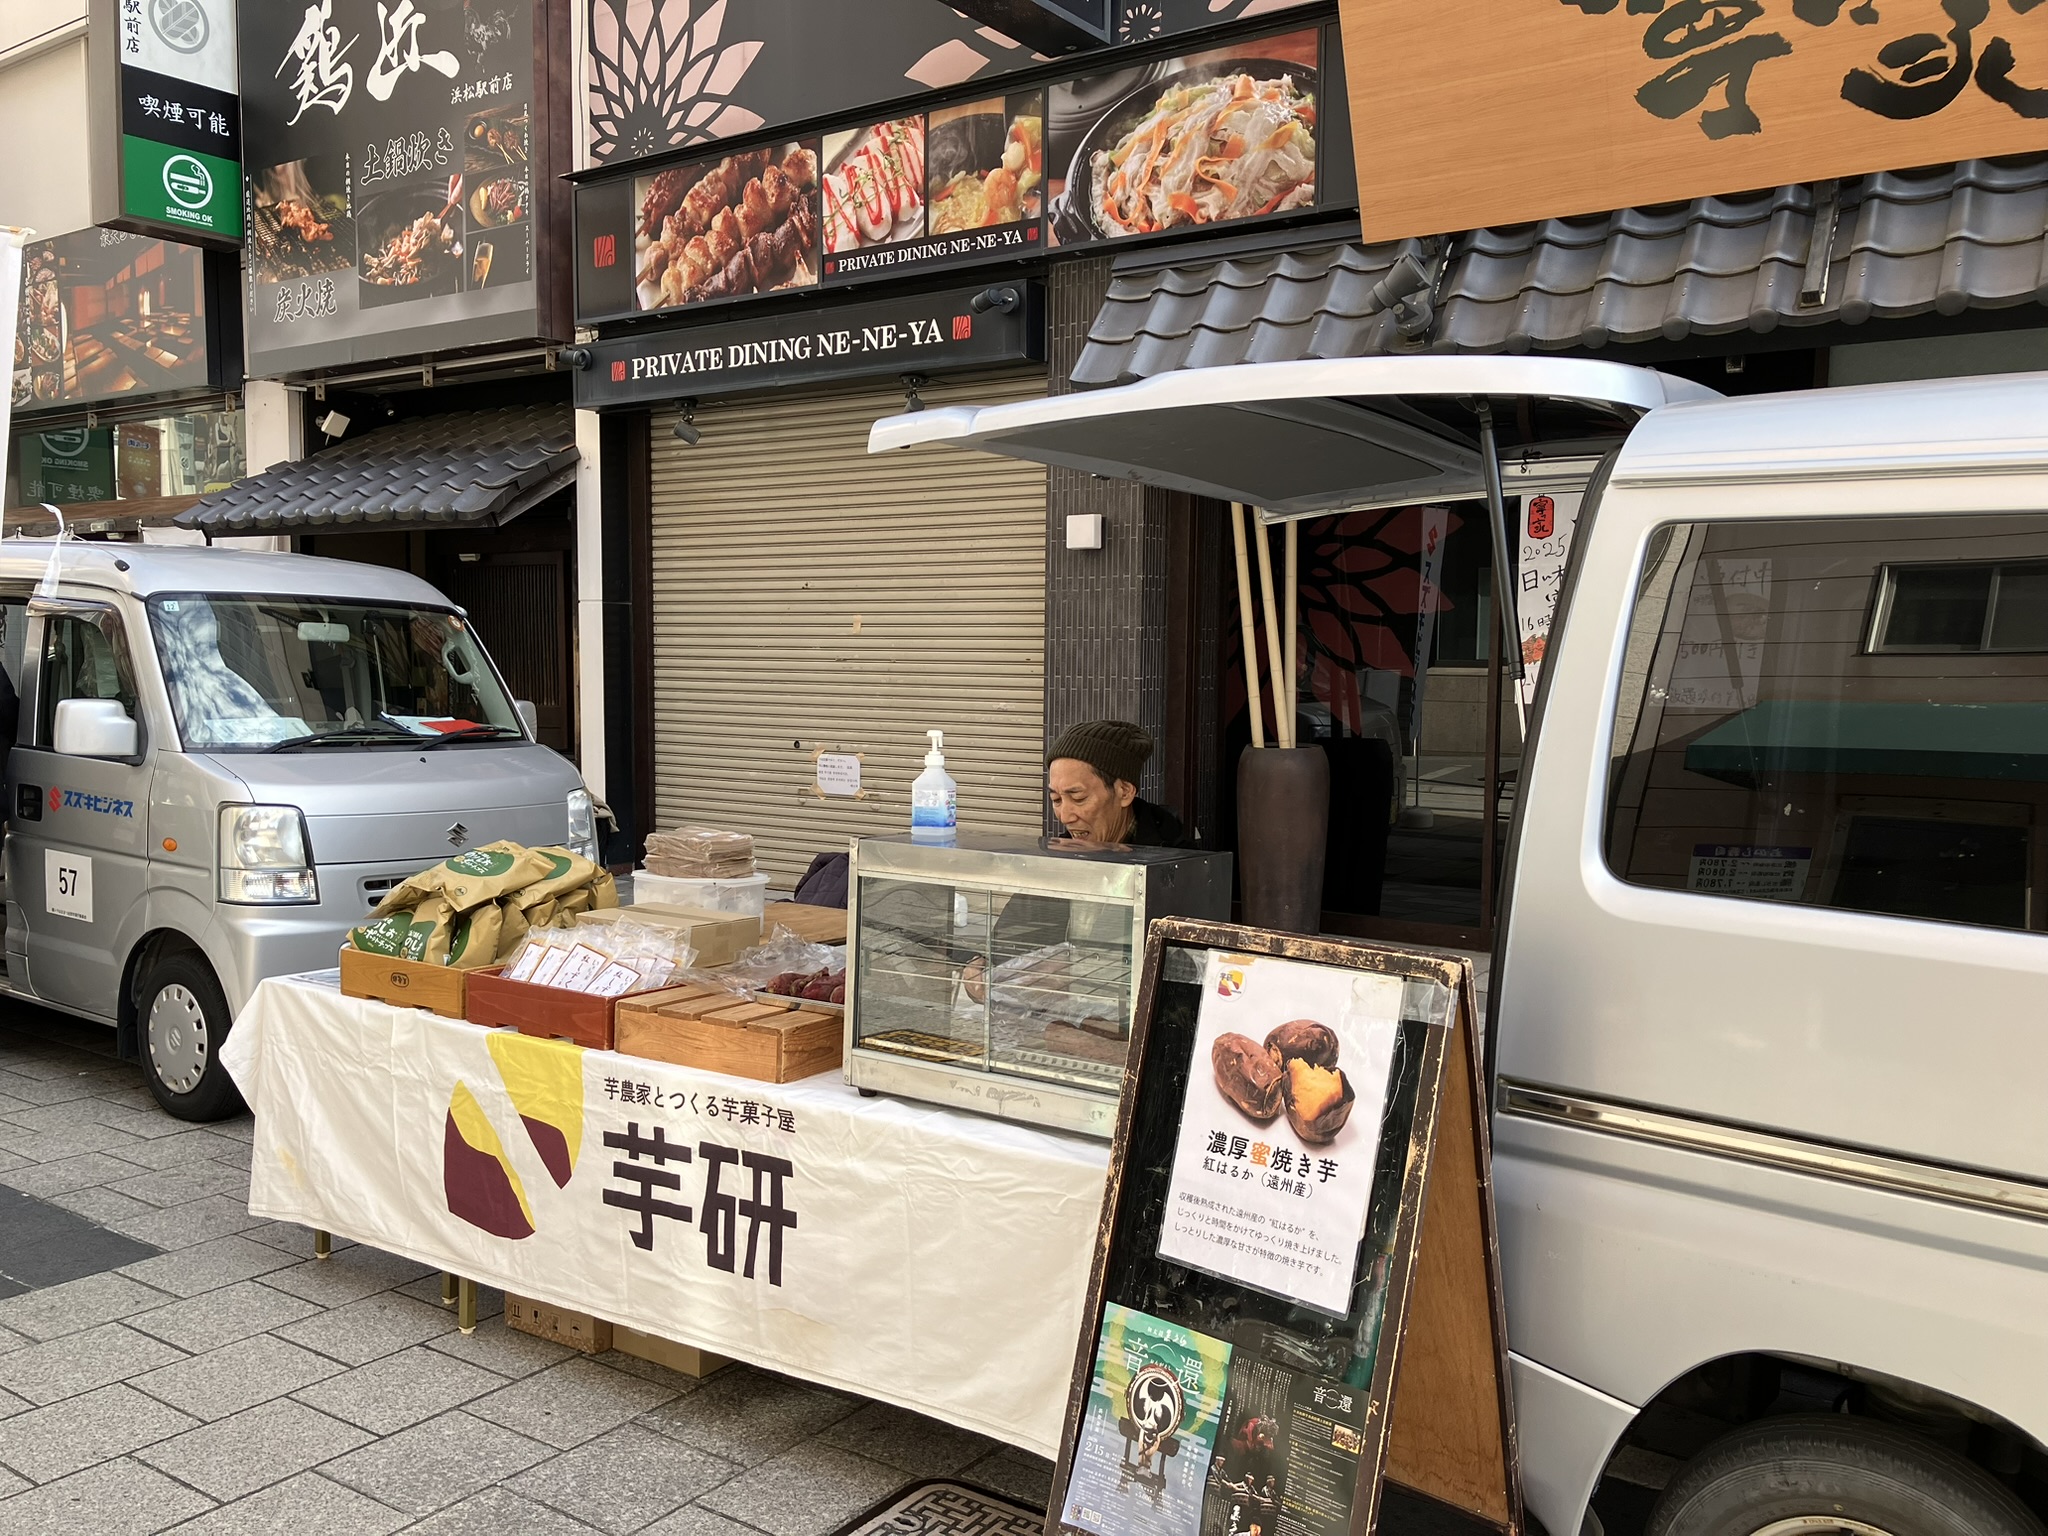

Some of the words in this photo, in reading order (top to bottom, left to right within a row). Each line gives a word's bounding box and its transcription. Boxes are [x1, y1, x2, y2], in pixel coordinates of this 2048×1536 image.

[123, 0, 142, 53] 駅前店
[450, 72, 513, 104] 浜松駅前店
[138, 95, 230, 136] 喫煙可能
[361, 127, 453, 186] 土鍋炊き
[166, 206, 201, 219] SMOKING
[202, 214, 213, 223] OK
[838, 252, 895, 273] PRIVATE
[897, 242, 947, 263] DINING
[950, 229, 1023, 254] NE-NE-YA
[274, 278, 338, 323] 炭火焼
[631, 347, 723, 380] PRIVATE
[728, 336, 812, 368] DINING
[816, 318, 944, 358] NE-NE-YA
[64, 790, 133, 818] スズキビジネス
[59, 867, 77, 896] 57
[604, 1077, 796, 1133] 芋農家とつくる芋菓子屋
[1206, 1130, 1339, 1183] 濃厚蜜焼き芋
[603, 1121, 797, 1287] 芋研
